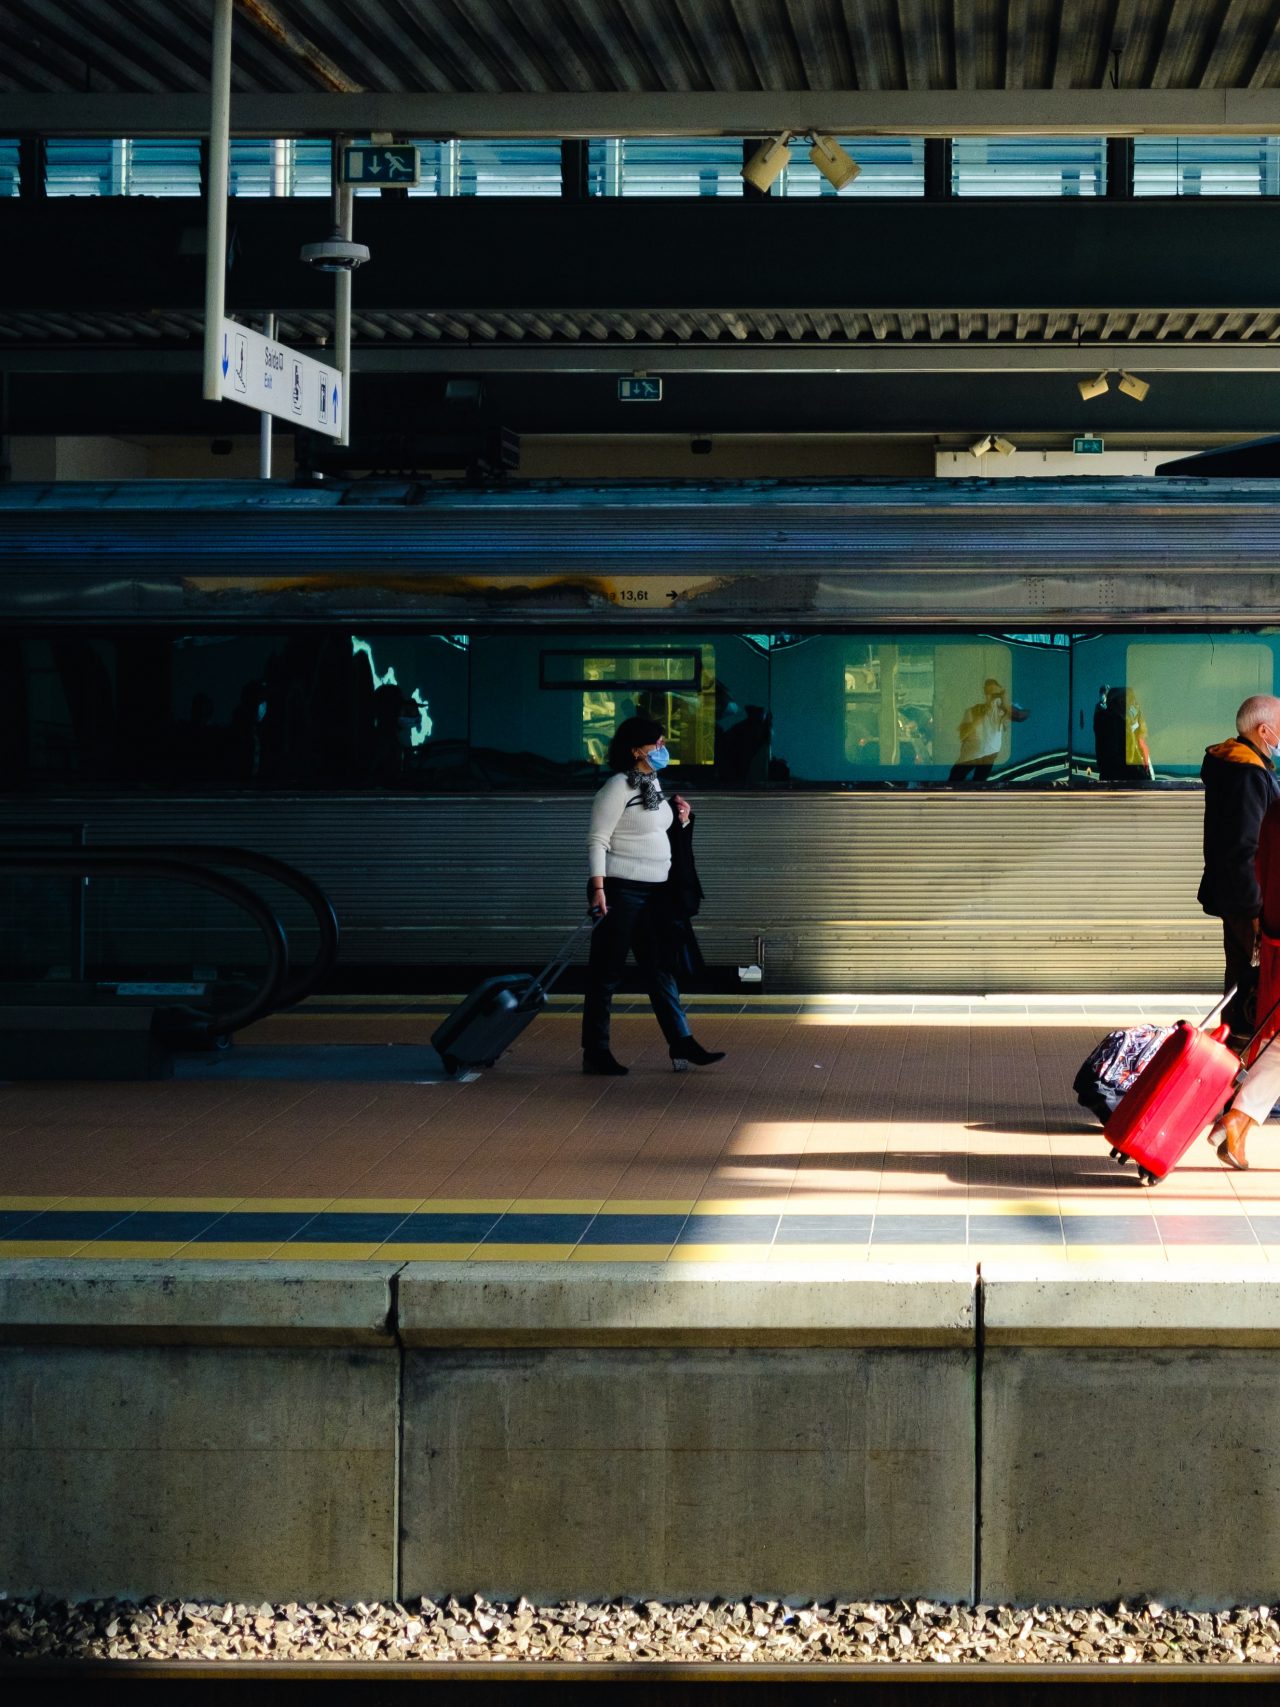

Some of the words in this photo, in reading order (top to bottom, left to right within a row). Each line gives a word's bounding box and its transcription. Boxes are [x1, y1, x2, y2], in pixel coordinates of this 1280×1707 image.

[264, 346, 279, 370] Saída
[264, 373, 273, 390] Exit
[620, 590, 649, 602] 13,6t
